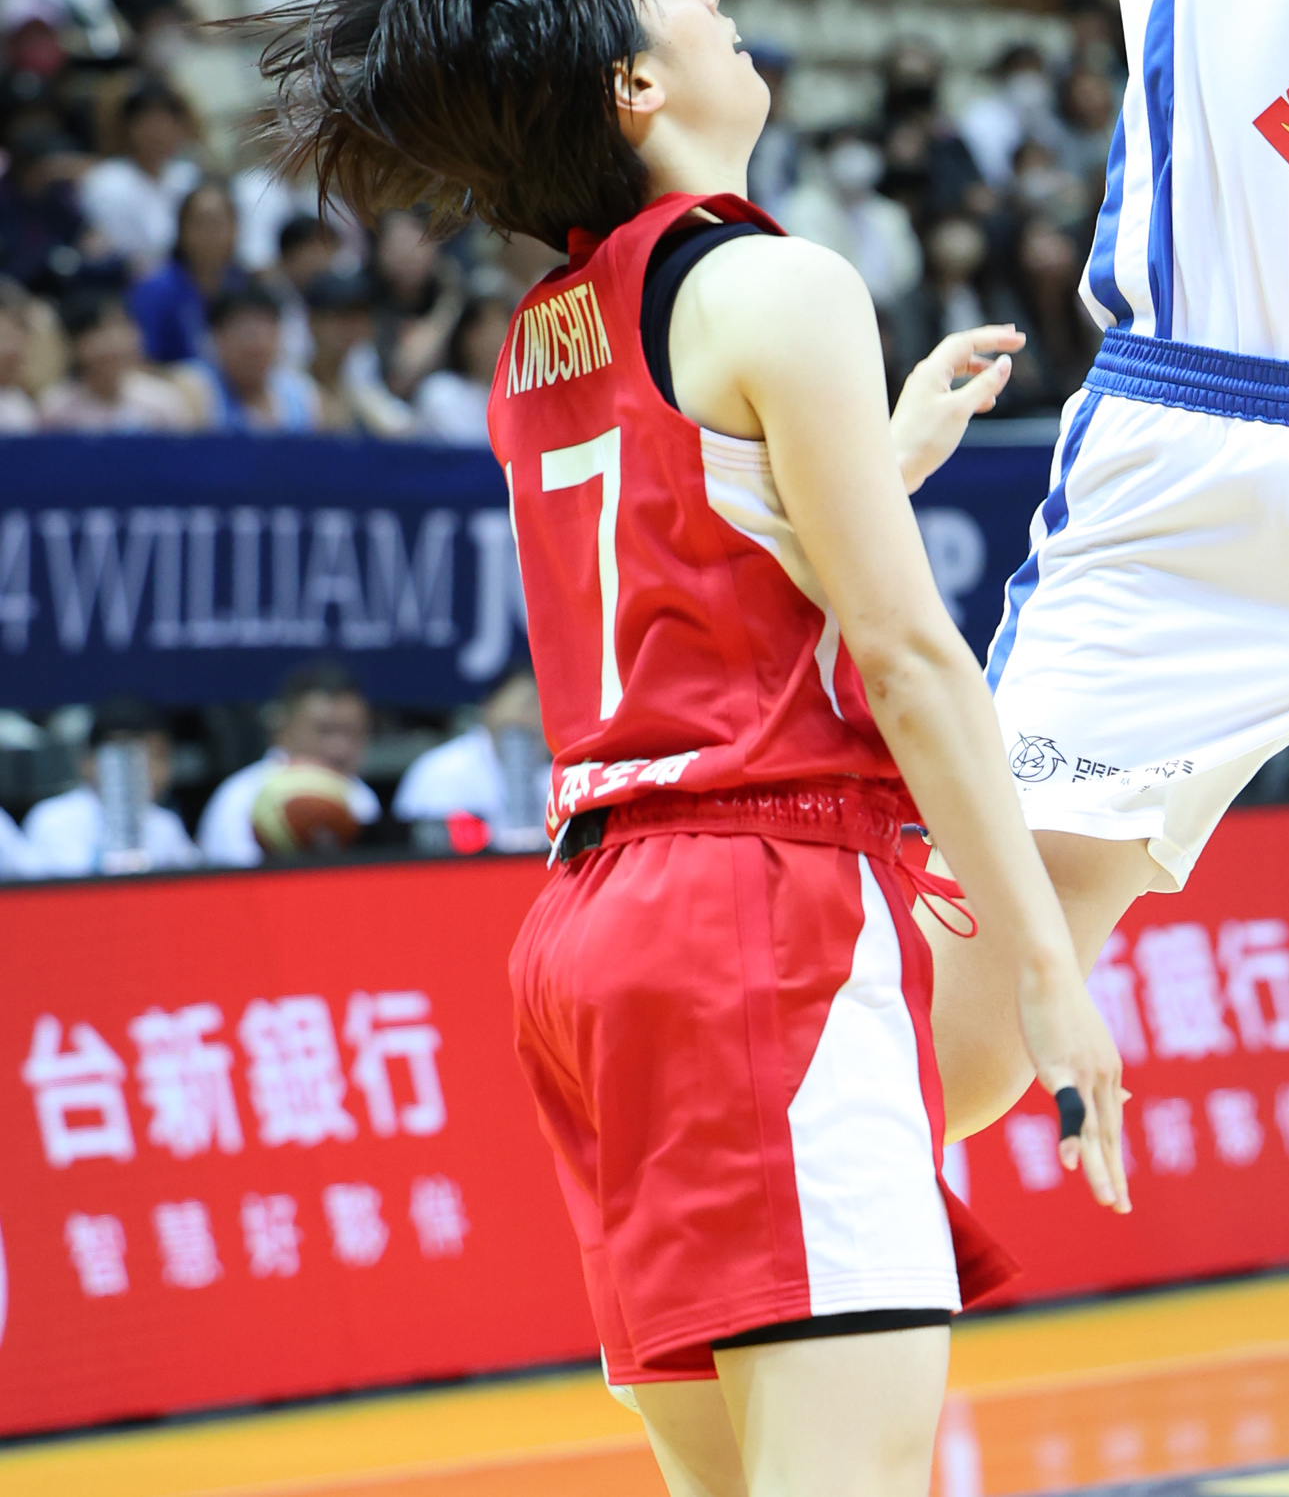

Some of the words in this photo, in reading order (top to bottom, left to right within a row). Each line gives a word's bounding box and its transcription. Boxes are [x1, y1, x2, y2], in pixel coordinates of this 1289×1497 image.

[506, 281, 612, 399] KINOSHITA
[38, 506, 458, 654] WILLIAM
[505, 425, 626, 722] 7
[545, 750, 700, 830] 本生命
[22, 990, 447, 1168] 台新銀行
